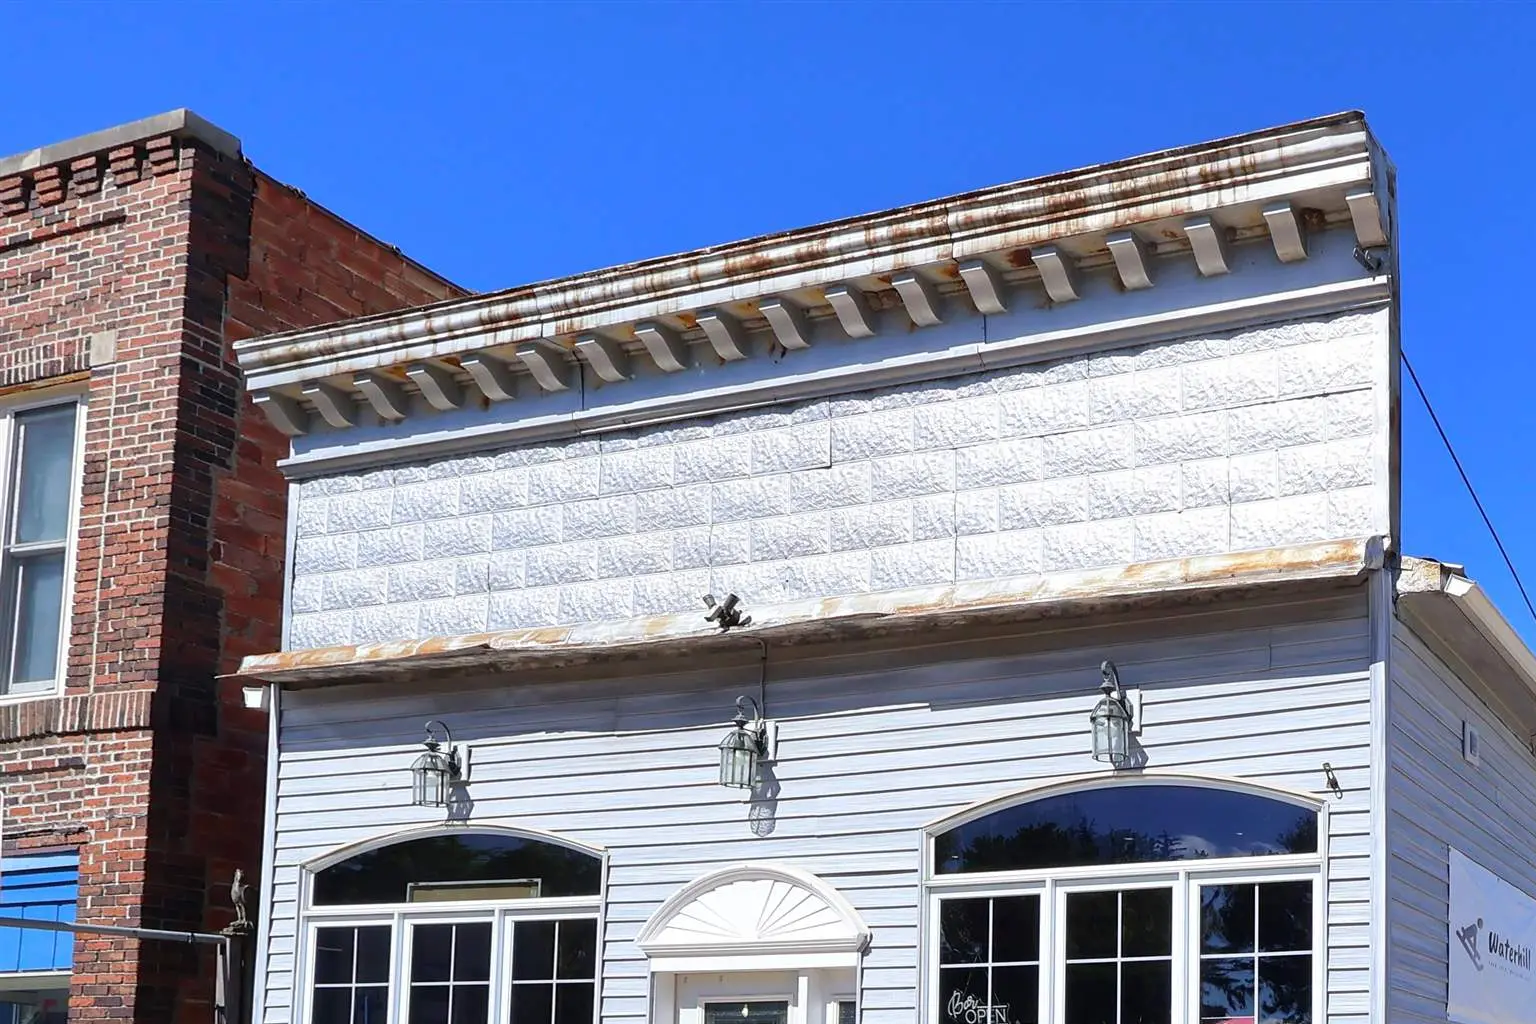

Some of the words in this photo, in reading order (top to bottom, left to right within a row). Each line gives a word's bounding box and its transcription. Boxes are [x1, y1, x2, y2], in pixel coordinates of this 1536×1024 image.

[1489, 931, 1531, 971] Waterhill
[947, 990, 979, 1019] Bar
[965, 1008, 1007, 1024] OPEN
